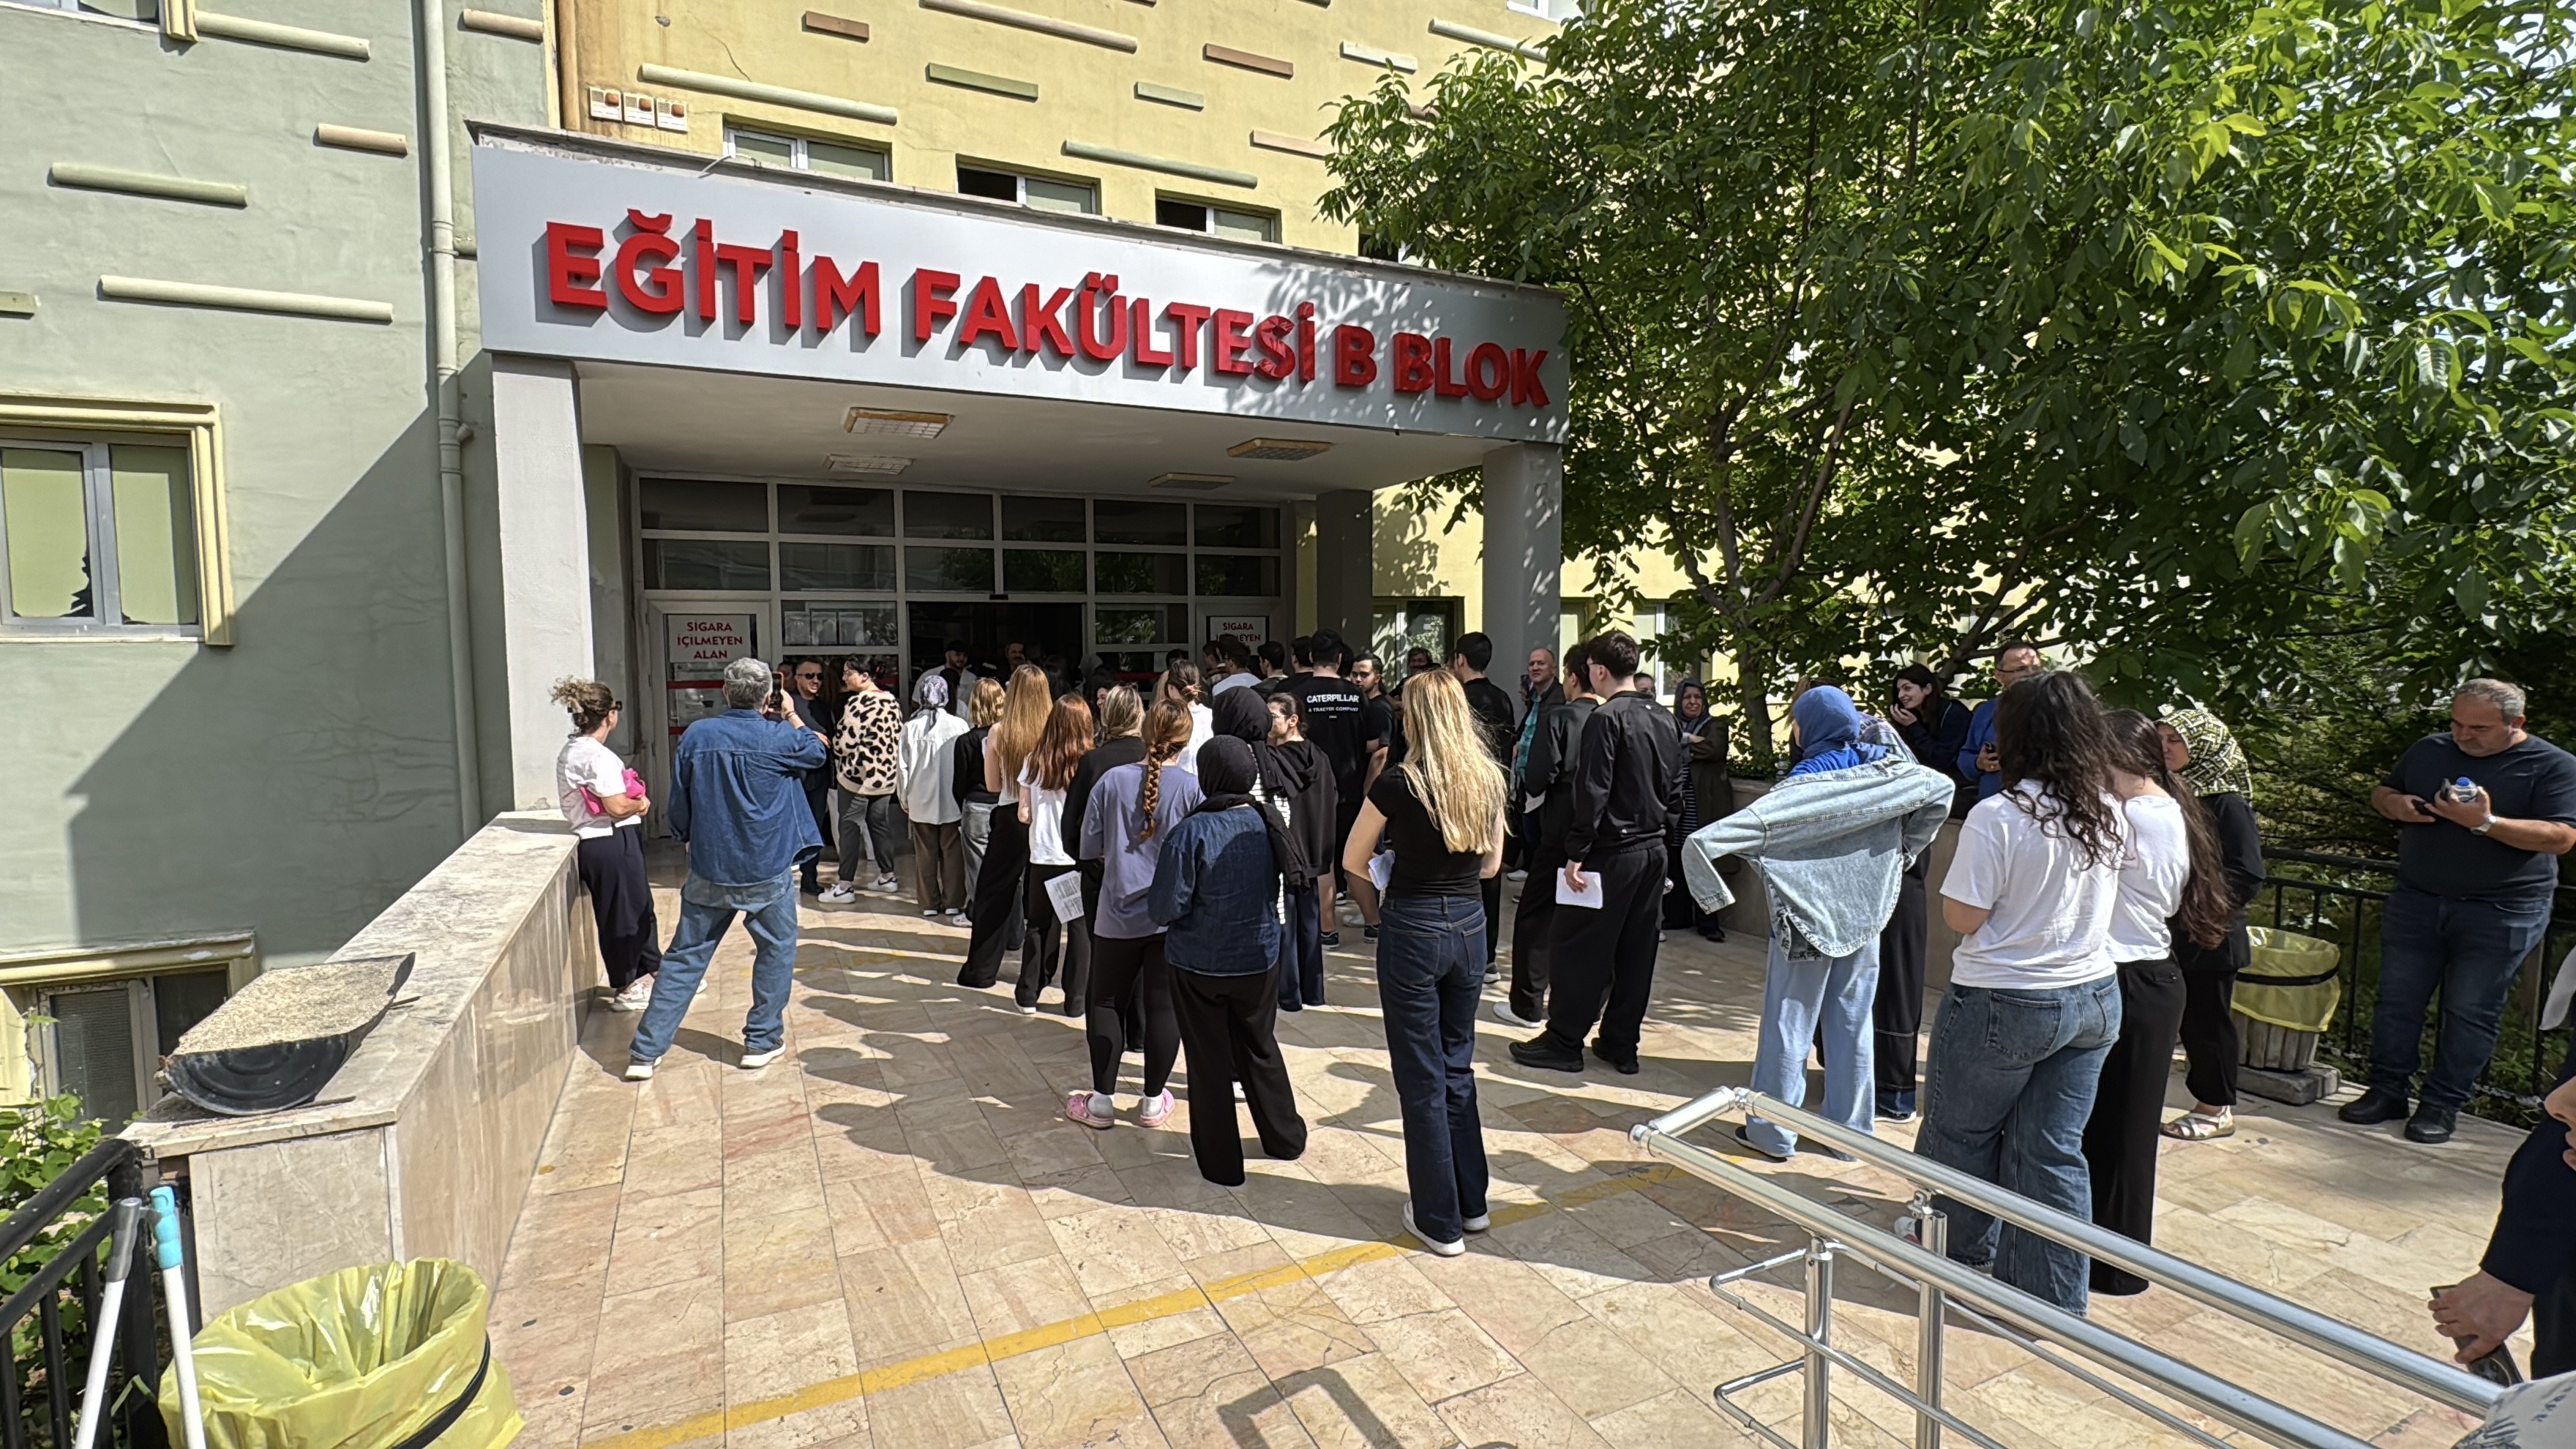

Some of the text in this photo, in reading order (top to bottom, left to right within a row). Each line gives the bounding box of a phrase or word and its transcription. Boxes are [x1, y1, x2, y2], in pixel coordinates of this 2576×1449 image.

[547, 209, 1550, 406] EĞİTİM FAKÜLTESİ B BLOK
[686, 621, 733, 632] SİGARA
[677, 634, 744, 648] İÇİLMEYEN
[693, 650, 727, 659] ALAN
[1306, 694, 1360, 703] CATERPILLAR
